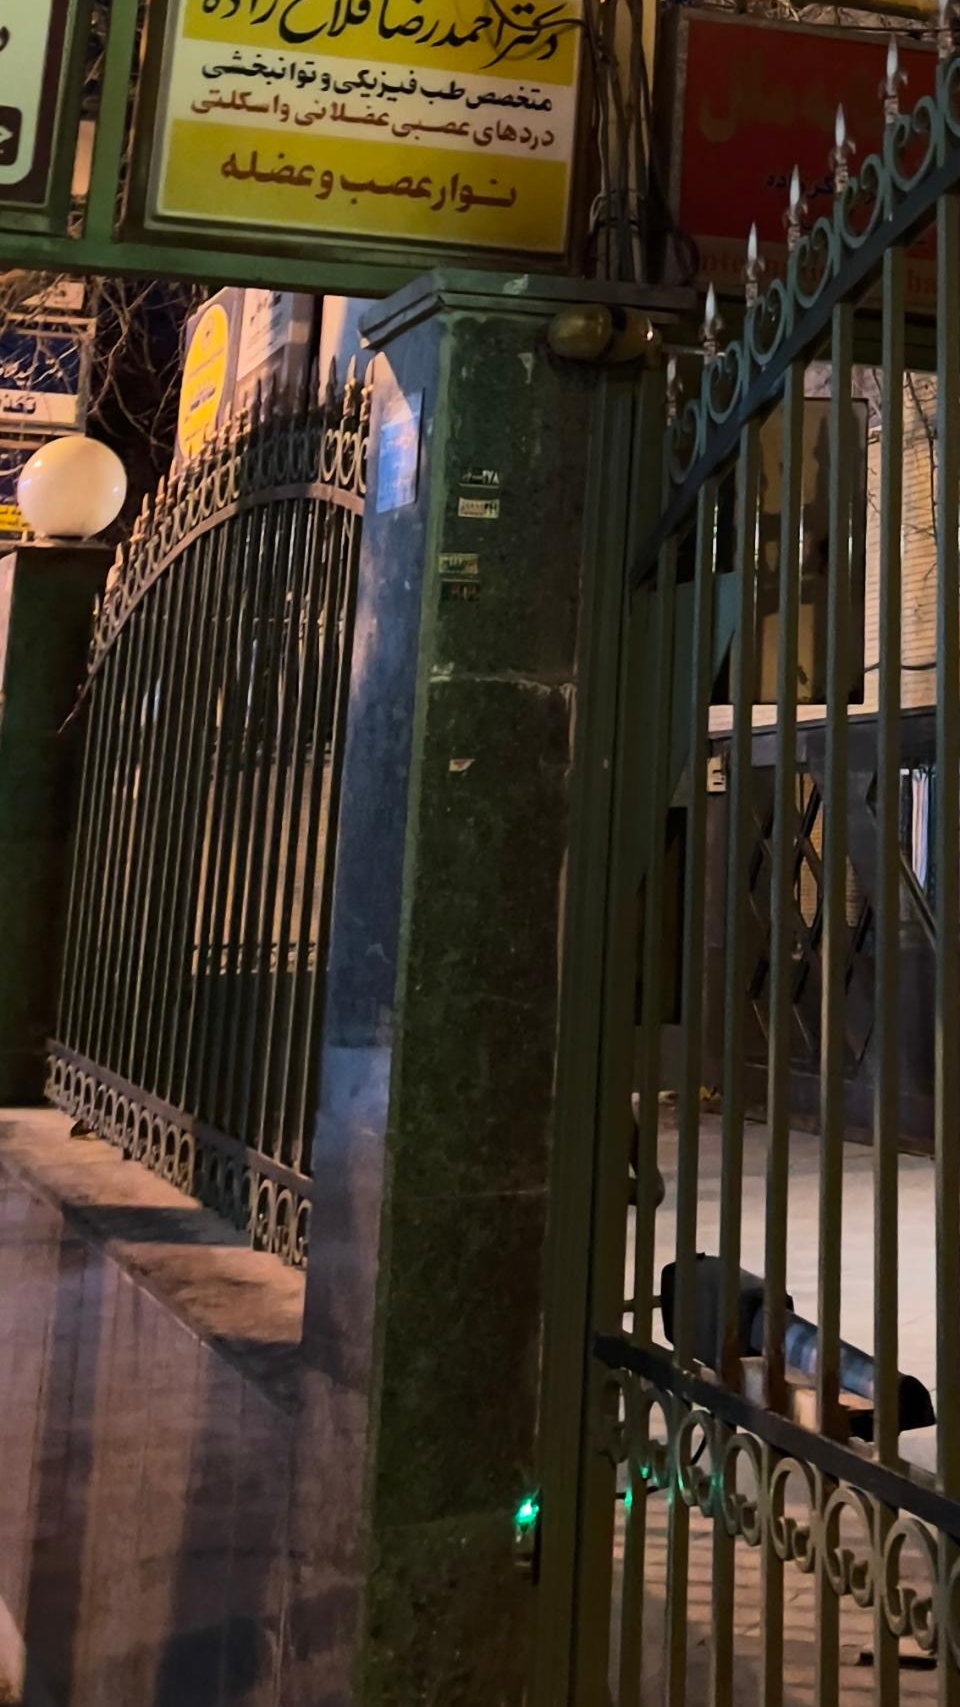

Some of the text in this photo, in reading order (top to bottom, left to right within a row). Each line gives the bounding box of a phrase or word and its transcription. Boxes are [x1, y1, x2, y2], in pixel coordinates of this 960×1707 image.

[202, 51, 551, 111] متخصص طب فیزیکی و توانبخشی
[191, 89, 554, 150] دردهای عصبی عضلانی و اسکلتی
[221, 151, 516, 212] نوار عصب و عضله
